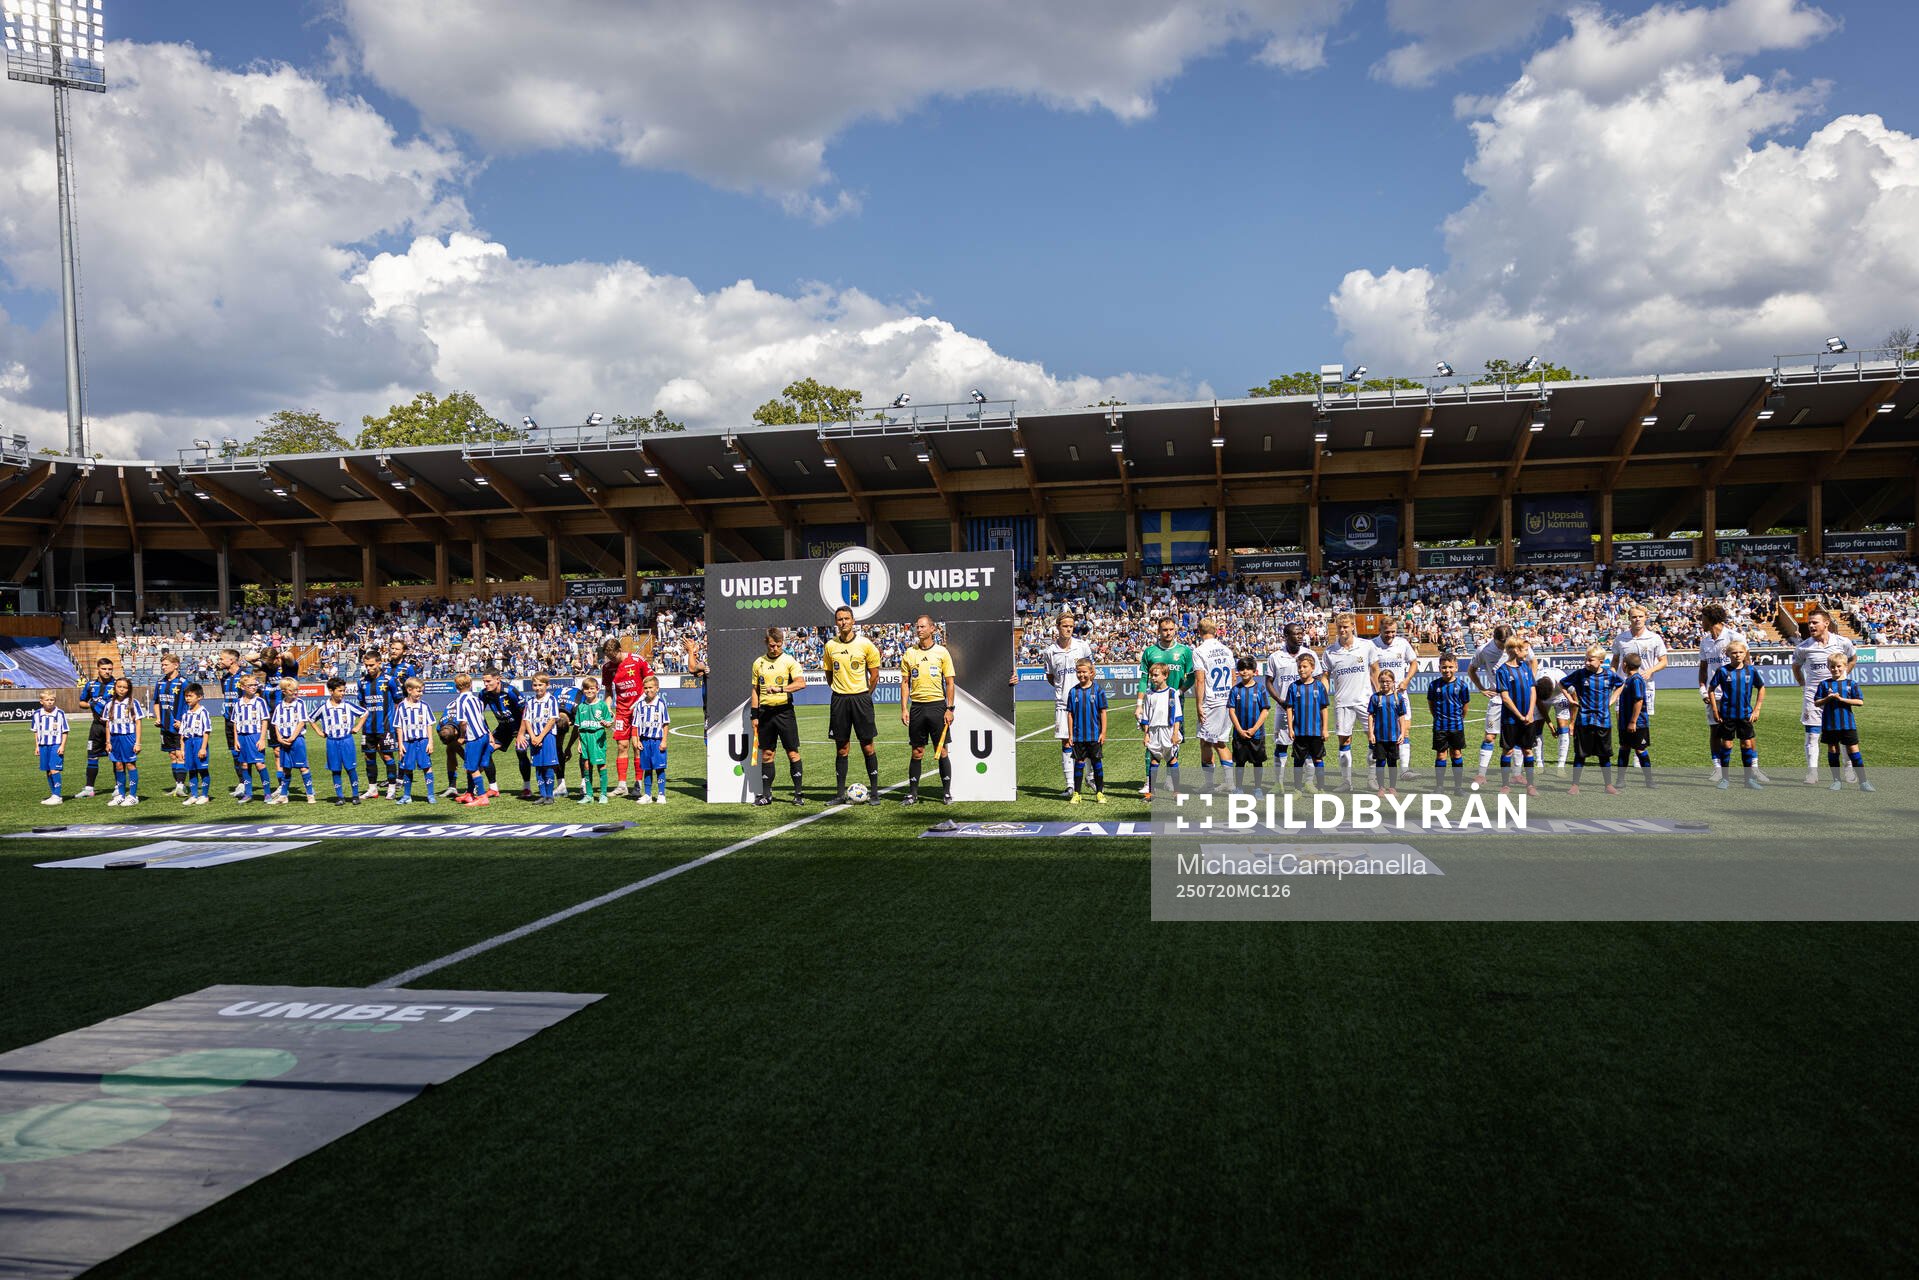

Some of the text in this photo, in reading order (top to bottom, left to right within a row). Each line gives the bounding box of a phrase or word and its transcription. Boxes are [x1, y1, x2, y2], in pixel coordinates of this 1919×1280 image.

[1547, 511, 1584, 520] Uppsala
[1547, 520, 1588, 528] kommun
[1867, 539, 1898, 547] match!
[1462, 553, 1476, 561] kör
[1477, 553, 1484, 561] vi
[1639, 549, 1687, 557] BILFORUM
[841, 563, 869, 573] SIRIUS
[908, 567, 995, 590] UNIBET
[587, 586, 623, 594] BILFORUM
[720, 575, 802, 597] UNIBET
[1337, 666, 1365, 676] SERNEKE
[1211, 666, 1231, 692] 22
[728, 734, 749, 762] U
[970, 729, 993, 759] U
[217, 1000, 496, 1024] UNIBET
